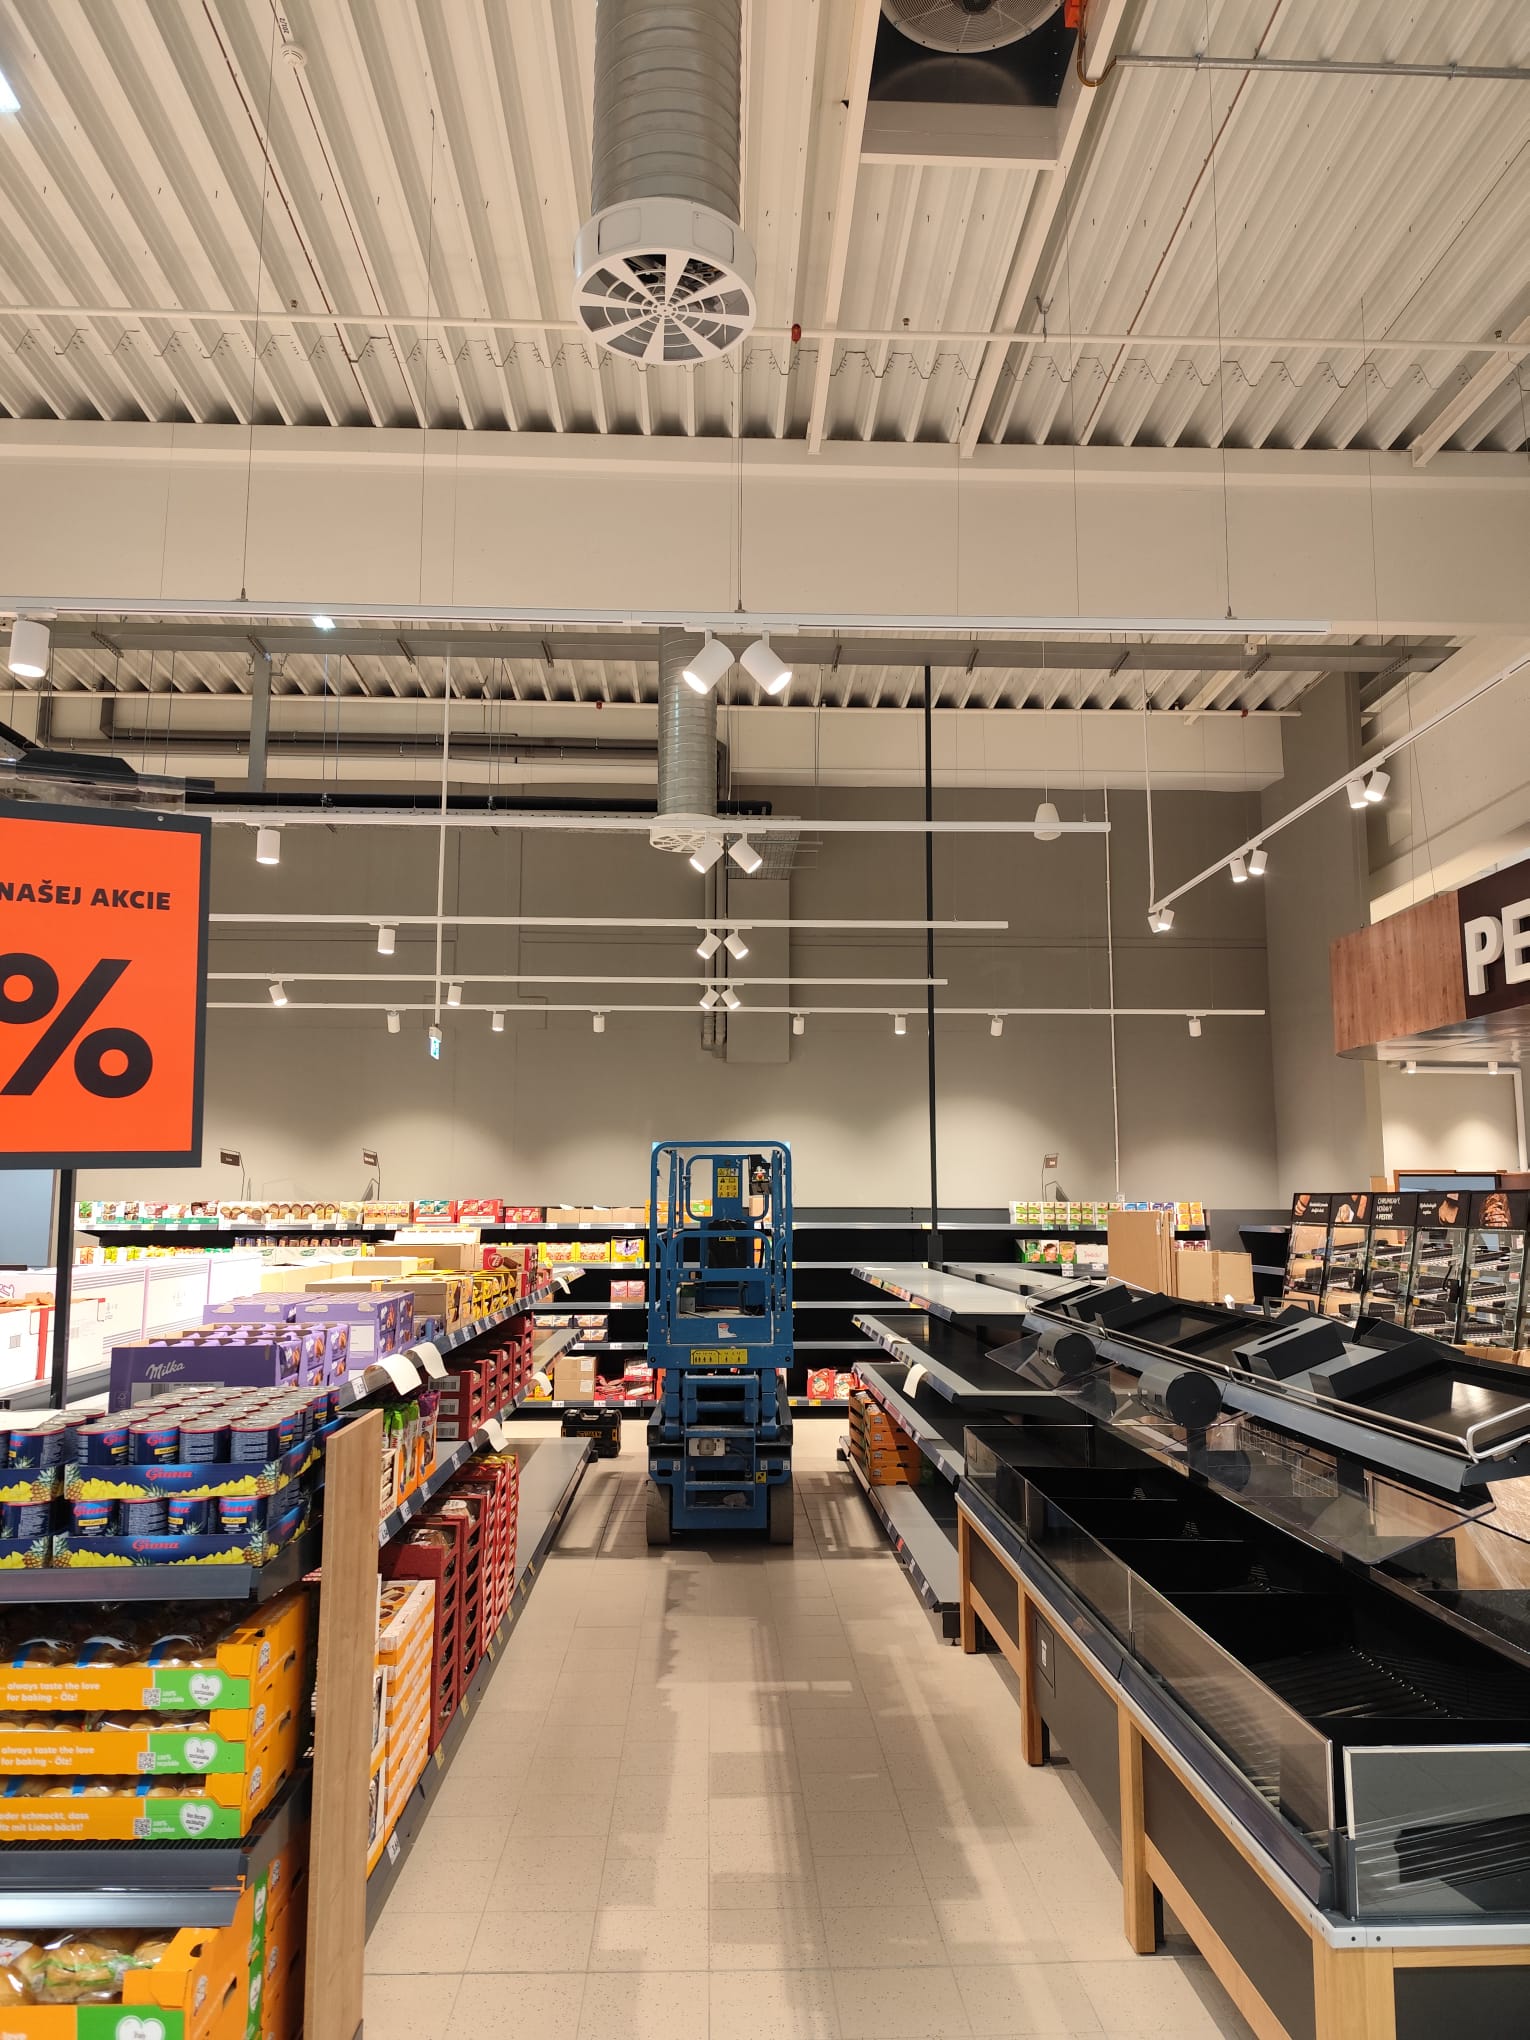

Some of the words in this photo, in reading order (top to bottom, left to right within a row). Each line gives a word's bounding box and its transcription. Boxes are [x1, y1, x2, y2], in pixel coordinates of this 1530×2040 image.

[0, 880, 82, 906] NAŠEJ
[90, 888, 171, 911] AKCIE
[1463, 898, 1530, 996] PE
[0, 952, 153, 1099] %
[146, 1360, 185, 1380] Milka
[146, 1467, 193, 1481] Giana
[132, 1538, 180, 1552] Giana
[7, 1683, 38, 1692] always
[65, 1682, 79, 1690] the
[81, 1682, 100, 1690] love
[21, 1694, 52, 1703] baking
[1, 1747, 32, 1756] always
[59, 1746, 74, 1754] the
[76, 1746, 95, 1754] love
[16, 1758, 46, 1767] baking
[68, 1812, 89, 1820] dass
[12, 1823, 26, 1831] mit
[28, 1823, 52, 1831] Liebe
